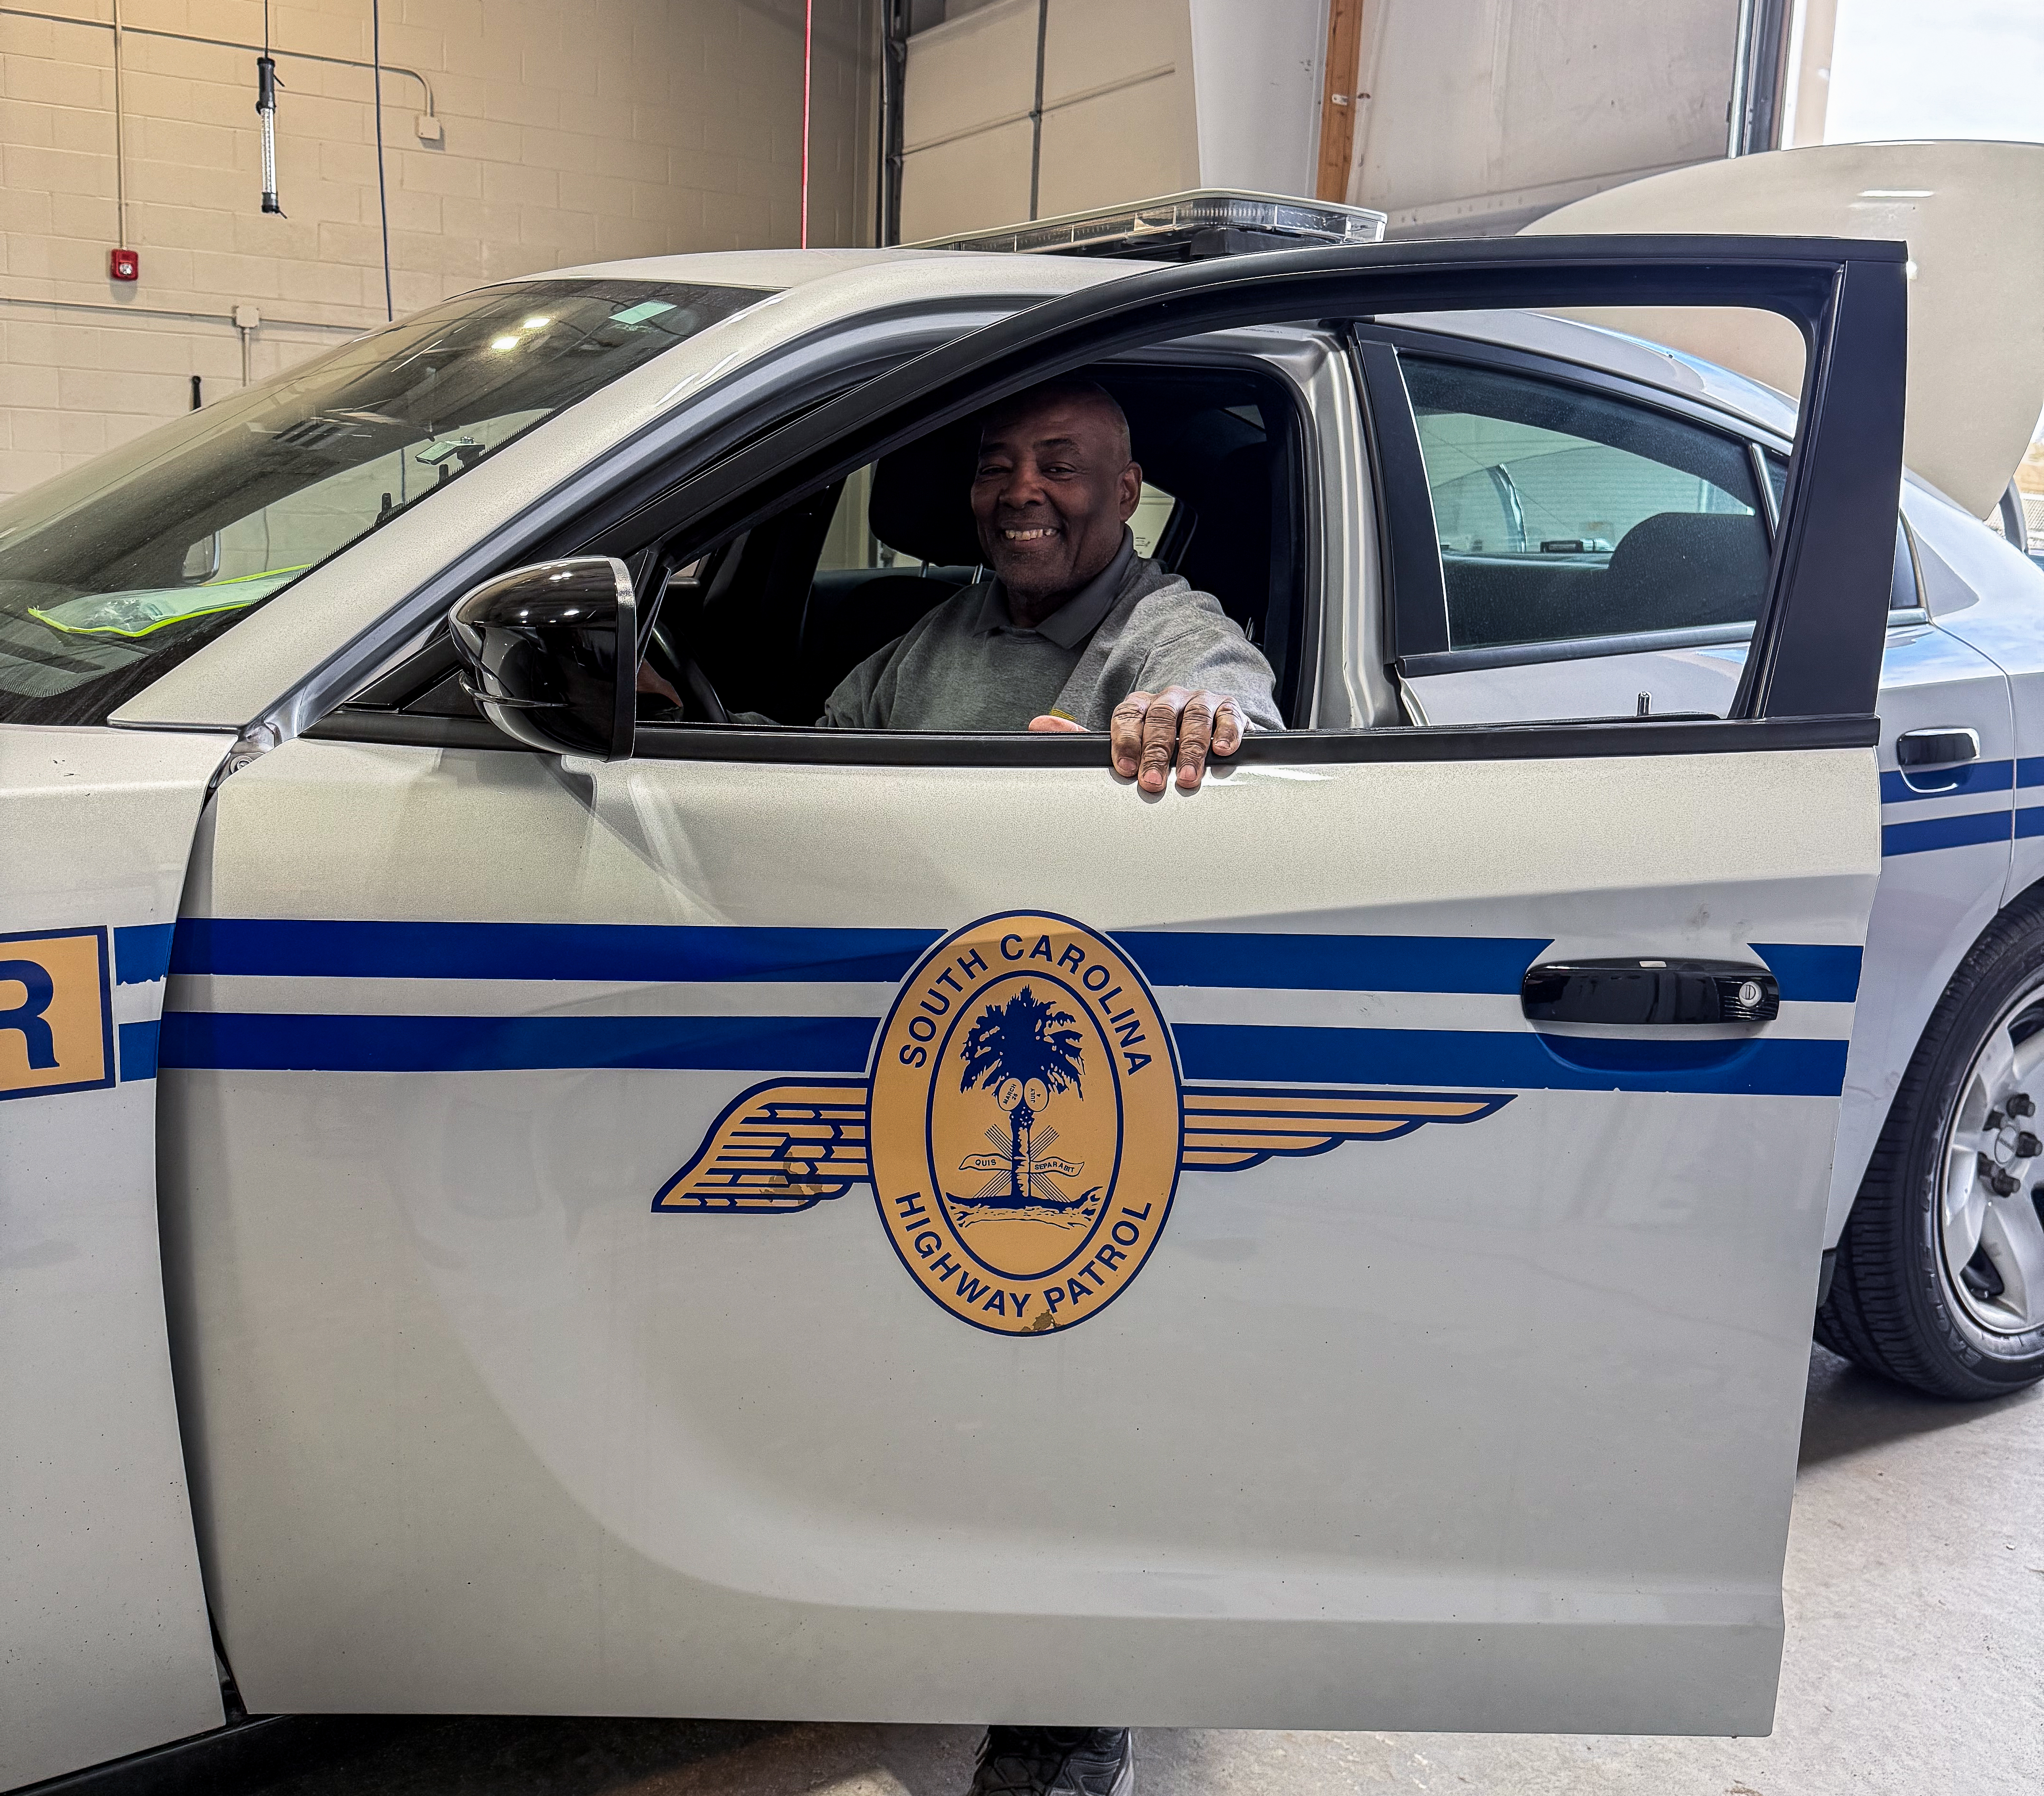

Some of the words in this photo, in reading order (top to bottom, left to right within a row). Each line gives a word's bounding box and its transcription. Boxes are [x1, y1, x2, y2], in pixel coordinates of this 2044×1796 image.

[899, 948, 988, 1069] SOUTH
[1000, 934, 1152, 1076] CAROLINA
[1003, 1083, 1016, 1105] MARCH
[975, 1159, 997, 1167] QUIS
[895, 1191, 1032, 1318] HIGHWAY
[1043, 1202, 1152, 1314] PATROL
